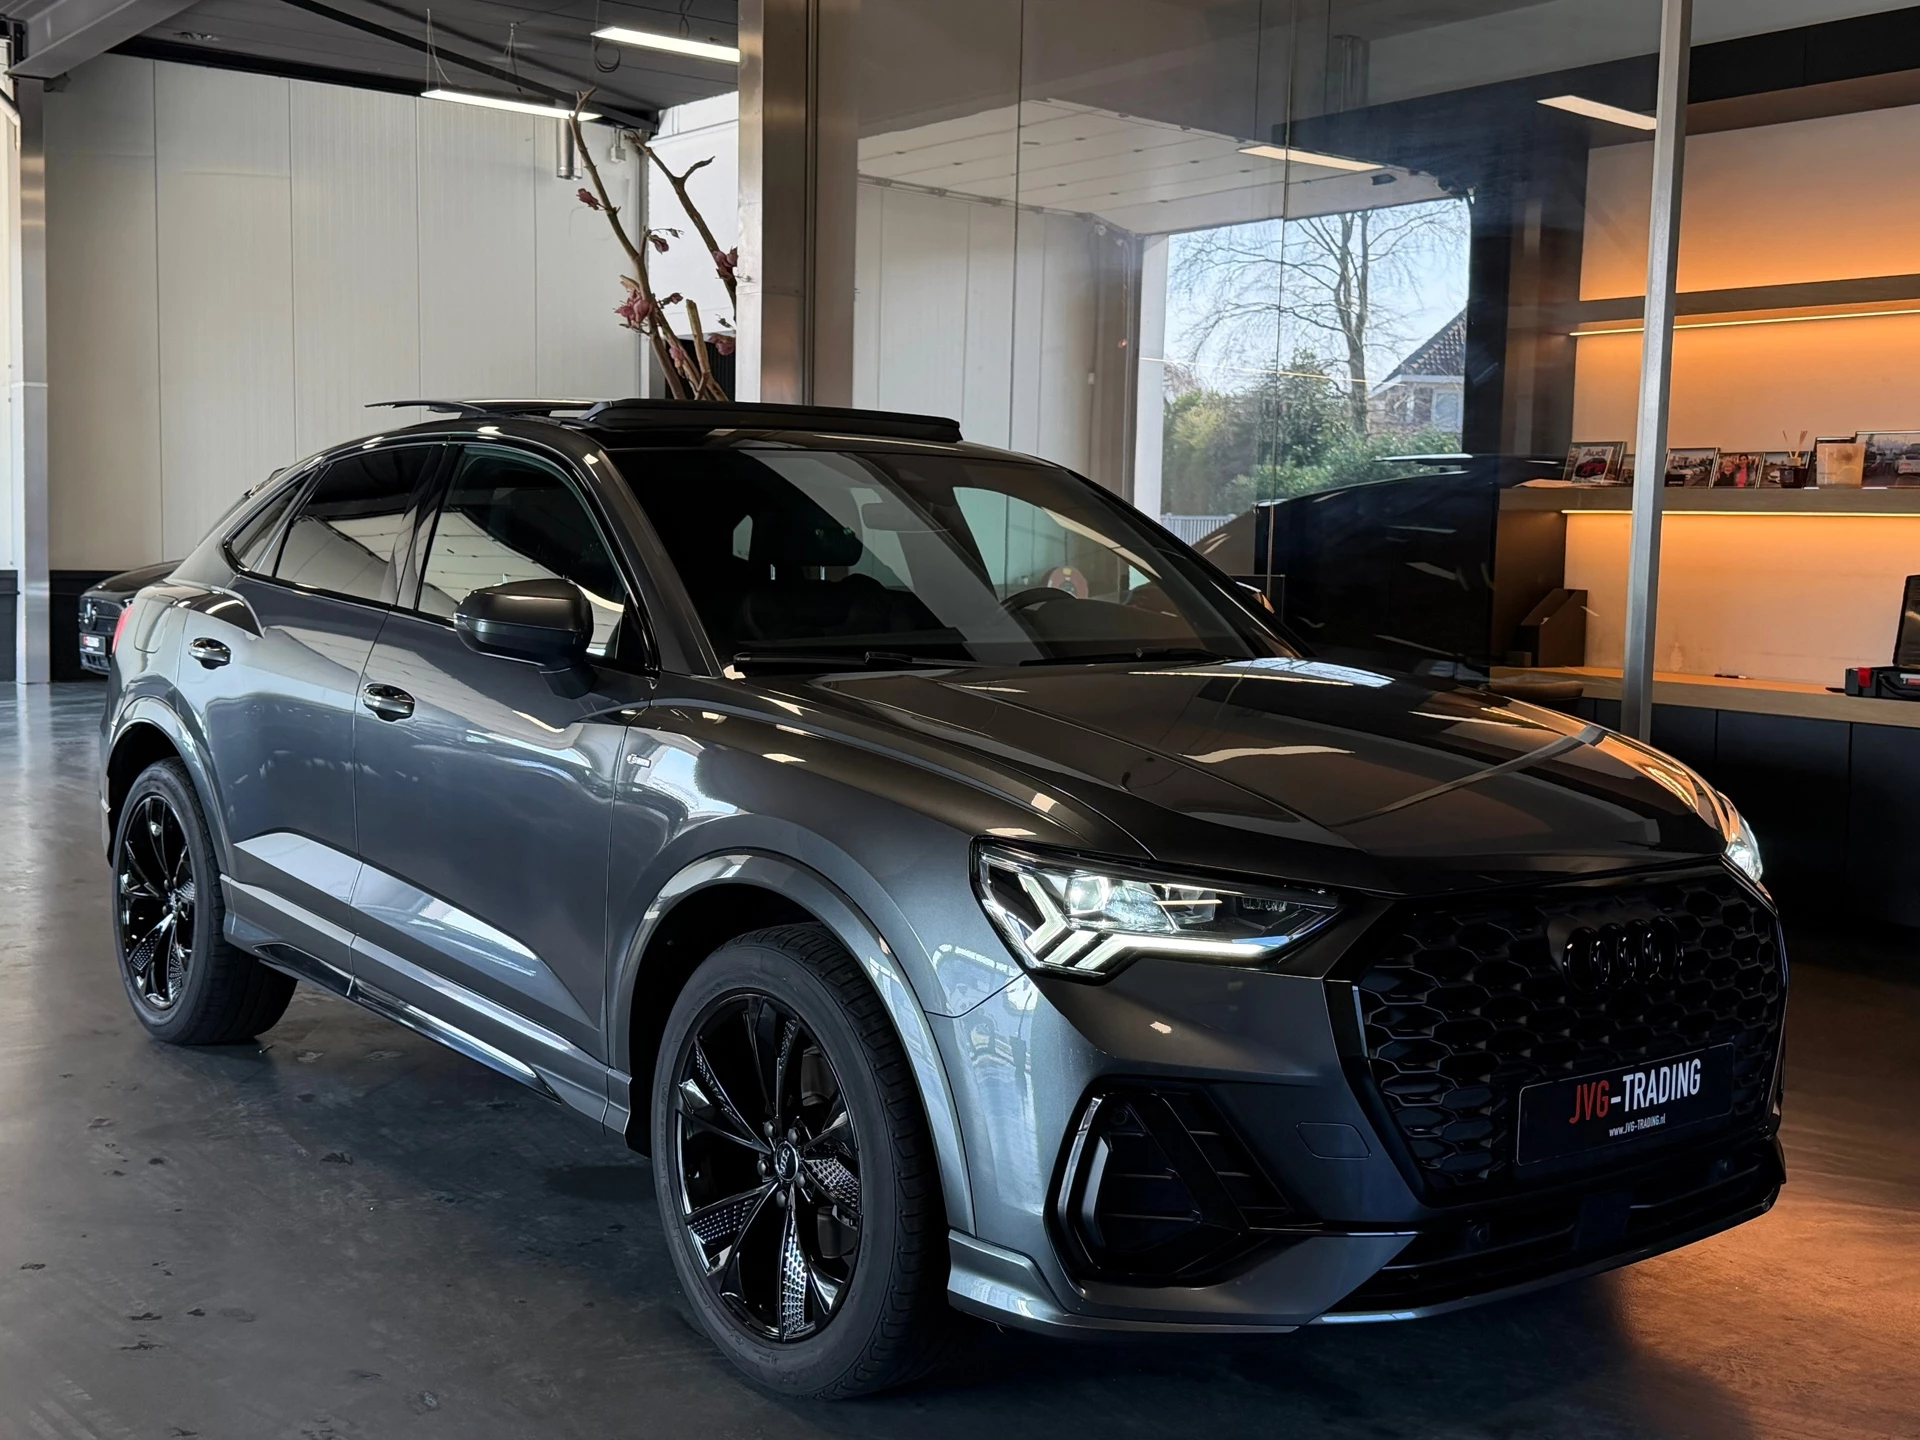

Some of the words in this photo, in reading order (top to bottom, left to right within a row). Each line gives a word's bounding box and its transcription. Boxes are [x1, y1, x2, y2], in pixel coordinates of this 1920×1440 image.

[1583, 448, 1607, 457] Audi
[1569, 1058, 1701, 1124] JVG-TRADING
[1609, 1113, 1666, 1137] www.JVG-TRADING.nl
